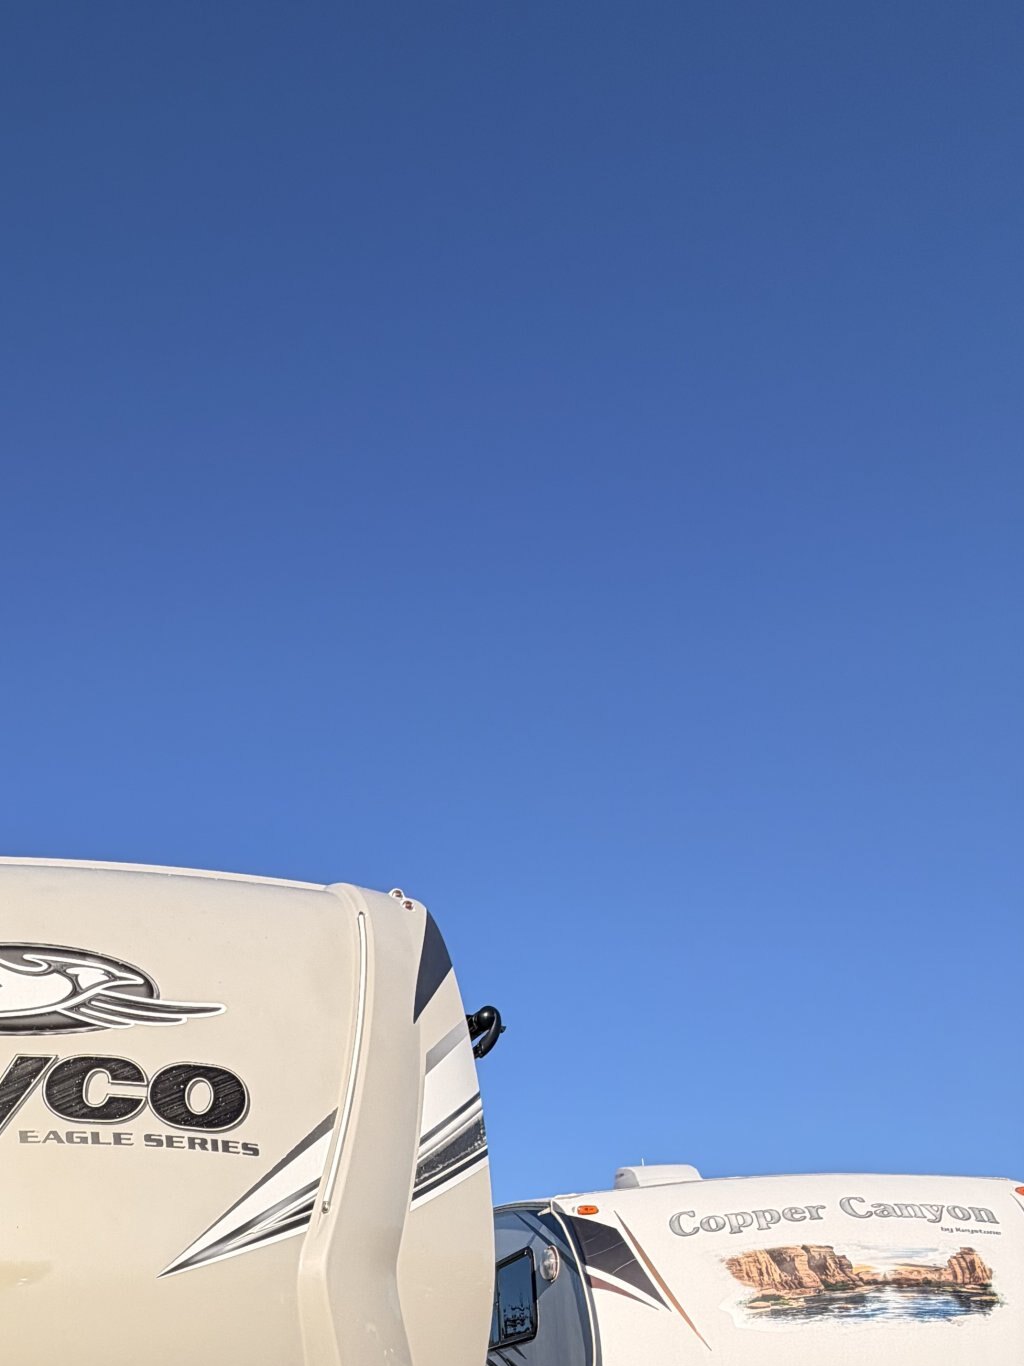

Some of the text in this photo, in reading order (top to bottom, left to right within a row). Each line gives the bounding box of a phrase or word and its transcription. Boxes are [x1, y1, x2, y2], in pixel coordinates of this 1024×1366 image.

[18, 1129, 260, 1157] EAGLE SERIES
[668, 1196, 1000, 1237] Copper Canyon
